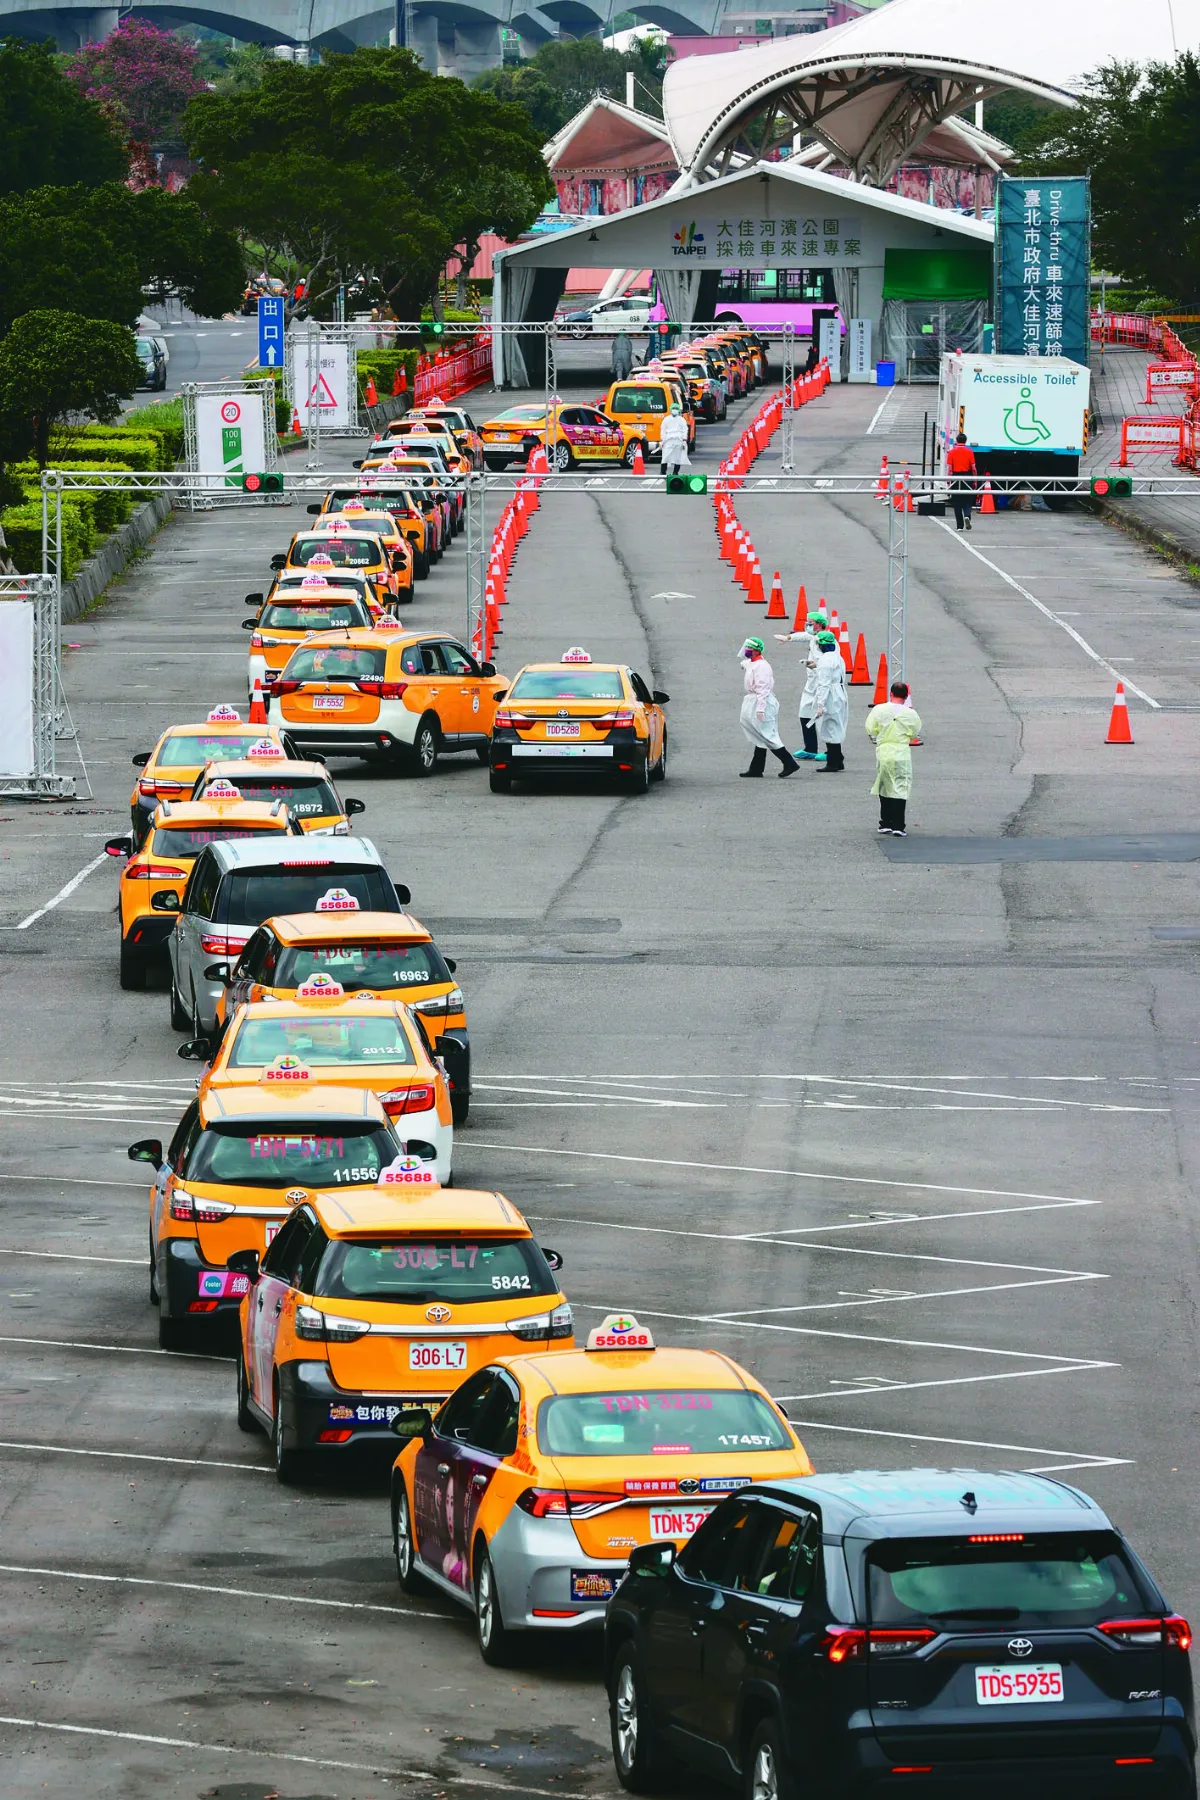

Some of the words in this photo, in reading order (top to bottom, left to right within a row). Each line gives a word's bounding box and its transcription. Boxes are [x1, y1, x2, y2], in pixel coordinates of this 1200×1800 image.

[717, 219, 839, 236] 大佳河濱公園
[1050, 190, 1062, 261] Drive-thru
[672, 246, 706, 255] TAIPEI
[717, 239, 861, 257] 採檢車來速專案
[263, 299, 279, 341] 出口
[973, 372, 1038, 385] Accessible
[1044, 373, 1077, 386] Toilet
[225, 407, 237, 417] 20
[224, 430, 239, 438] 100
[229, 439, 237, 447] m
[330, 619, 349, 627] 9356
[206, 790, 237, 798] 55688
[293, 803, 323, 813] 18972
[320, 901, 356, 910] 55688
[392, 970, 430, 982] 16963
[302, 988, 340, 996] 55688
[362, 1046, 402, 1055] 20123
[266, 1071, 309, 1080] 55688
[246, 1136, 345, 1158] TDH-5771
[333, 1168, 378, 1183] 11556
[385, 1173, 432, 1183] 55688
[393, 1245, 480, 1269] 306-L7
[491, 1275, 531, 1290] 5842
[596, 1335, 648, 1346] 55688
[602, 1394, 713, 1412] TDN-3220
[718, 1434, 772, 1446] 17457
